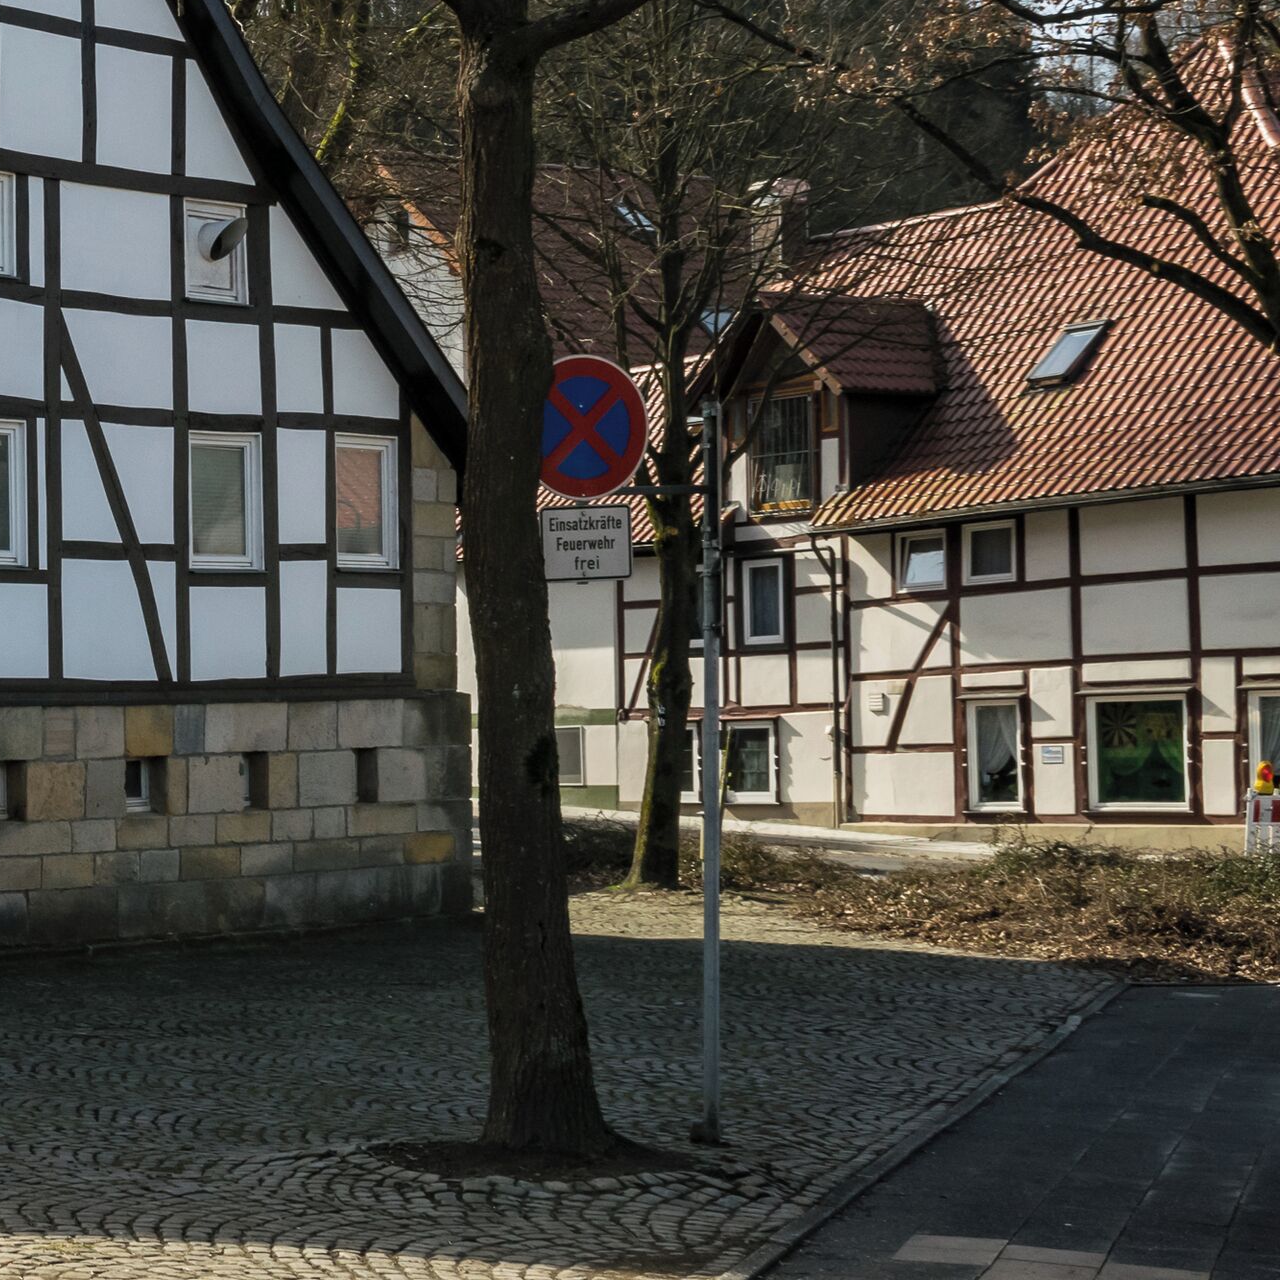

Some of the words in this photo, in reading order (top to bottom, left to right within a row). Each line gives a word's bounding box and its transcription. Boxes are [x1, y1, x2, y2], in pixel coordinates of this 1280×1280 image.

[549, 515, 622, 532] Einsatzkräfte
[556, 536, 615, 551] Feuerwehr
[574, 556, 600, 570] frei
